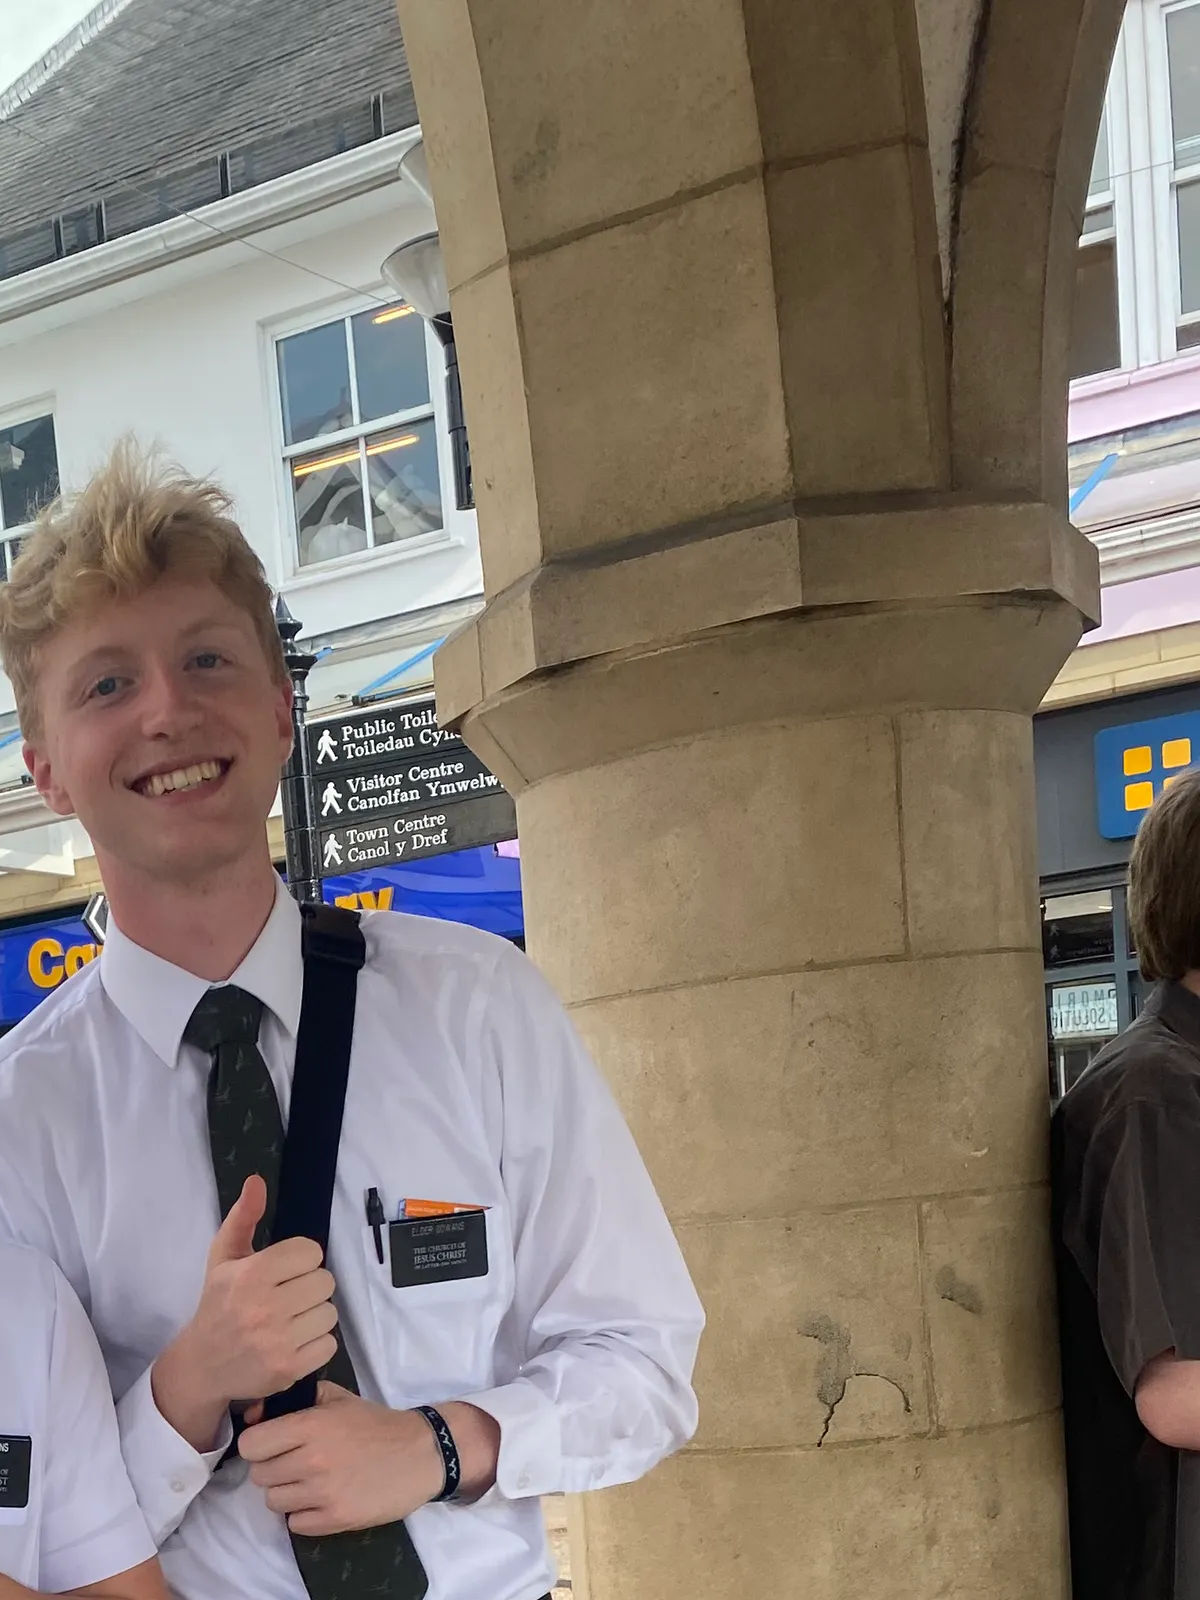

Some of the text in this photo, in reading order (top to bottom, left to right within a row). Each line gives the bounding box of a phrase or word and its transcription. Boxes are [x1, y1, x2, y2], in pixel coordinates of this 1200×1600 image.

[342, 720, 395, 742] Public
[343, 736, 415, 759] Toiledau
[347, 761, 464, 794] Visitor Centre
[347, 772, 504, 812] Canolfan Ymwelw
[347, 813, 446, 845] Town Centre
[347, 828, 448, 862] Canol y Dref
[28, 937, 104, 988] Ca
[411, 1225, 434, 1237] ELDER
[413, 1241, 467, 1254] THE CHURCH OF
[414, 1249, 467, 1265] JESUS CHRIST
